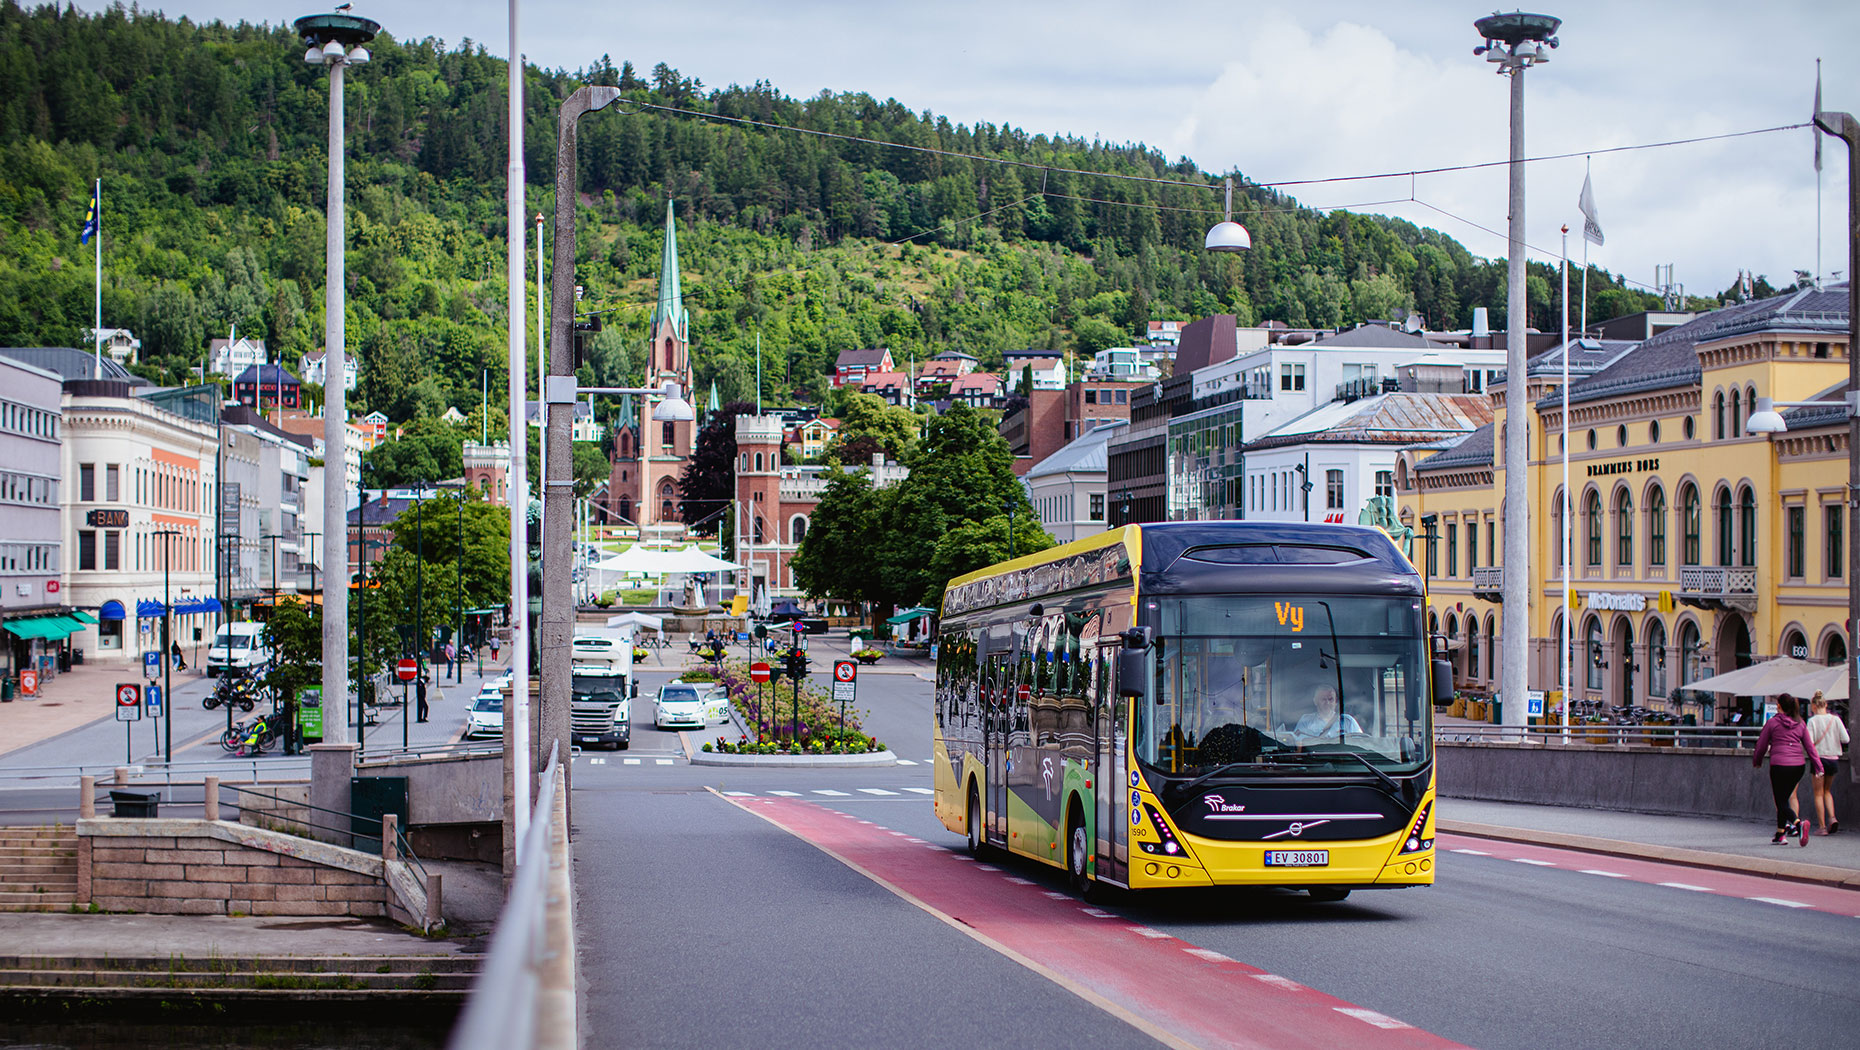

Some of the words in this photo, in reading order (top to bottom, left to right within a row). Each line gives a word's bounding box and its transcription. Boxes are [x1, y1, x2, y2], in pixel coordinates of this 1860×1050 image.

[1587, 461, 1632, 477] DRAMMENS
[97, 511, 126, 526] BANK
[1587, 592, 1646, 611] McDonald's
[1275, 602, 1304, 632] Vy
[1792, 646, 1808, 657] EGO
[1221, 804, 1246, 812] Brakar
[1275, 852, 1288, 863] EV
[1293, 852, 1325, 863] 30801
